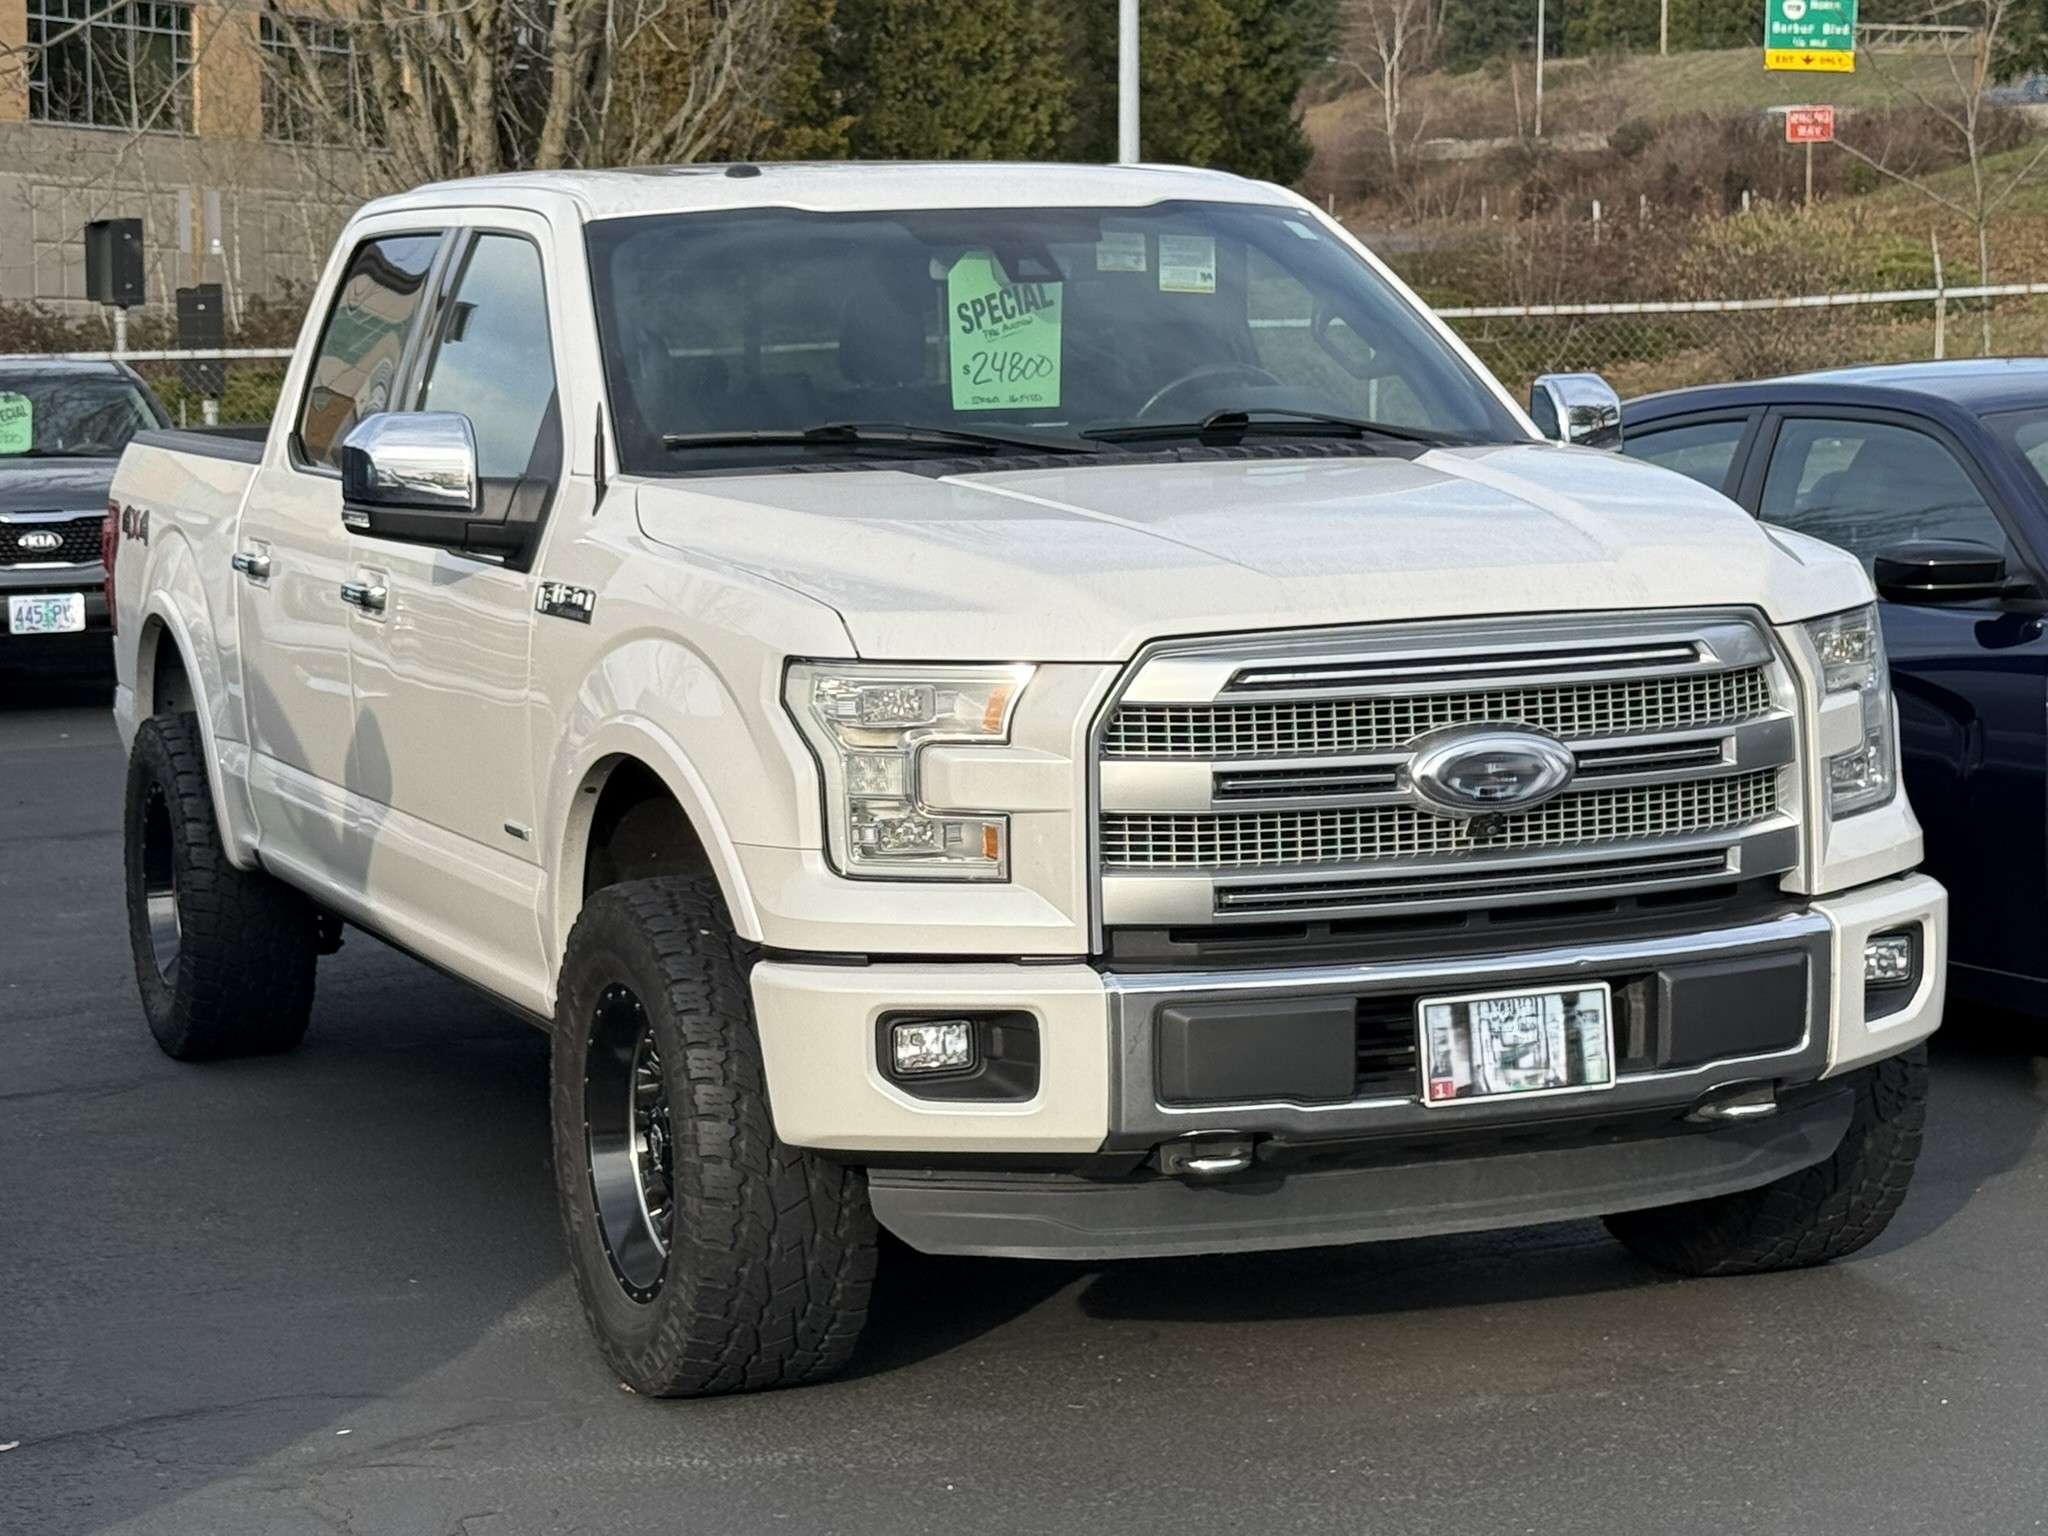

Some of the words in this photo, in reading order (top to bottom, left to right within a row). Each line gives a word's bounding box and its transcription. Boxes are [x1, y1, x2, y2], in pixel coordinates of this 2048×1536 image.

[957, 282, 1055, 335] SPECIAL
[961, 351, 1054, 385] $24800
[27, 534, 57, 547] KIA
[15, 604, 44, 625] 445
